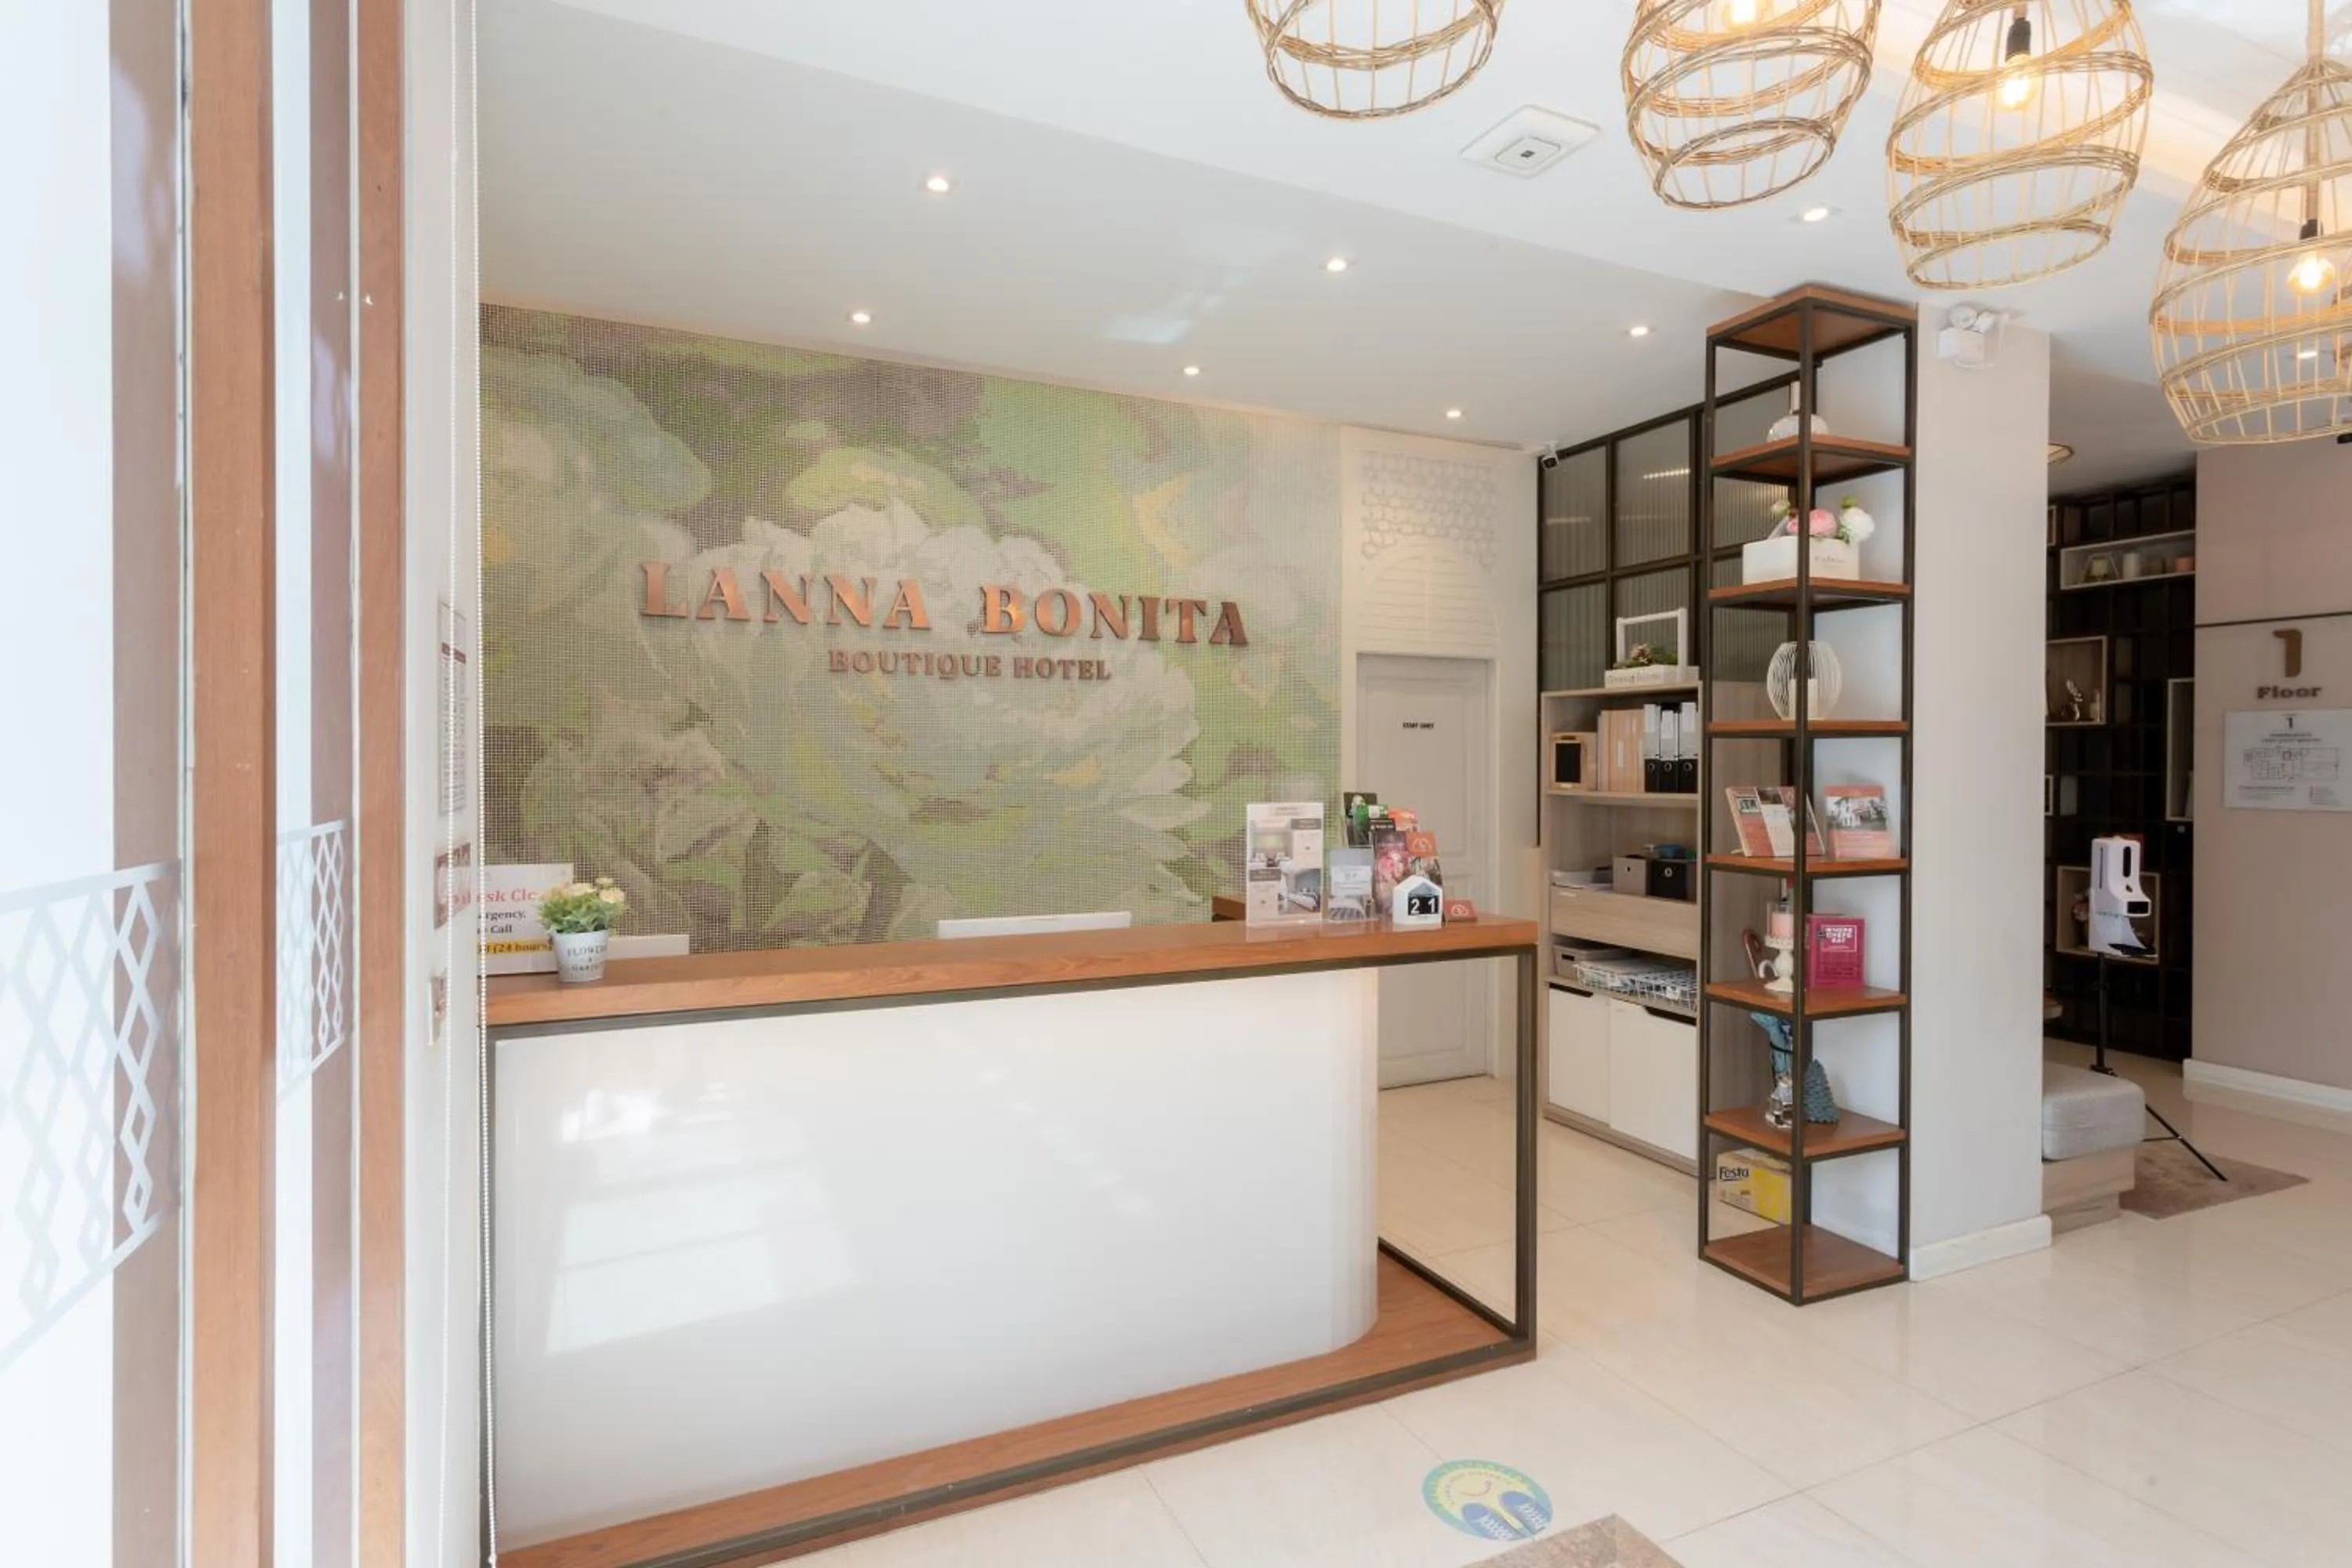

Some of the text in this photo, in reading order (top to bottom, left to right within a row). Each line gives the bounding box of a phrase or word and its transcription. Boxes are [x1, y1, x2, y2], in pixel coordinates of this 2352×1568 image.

[640, 560, 1248, 645] LANNA BONITA
[829, 648, 1112, 681] BOUTIQUE HOTEL
[2272, 630, 2303, 677] 1
[2256, 686, 2322, 699] Floor
[490, 924, 512, 934] Call
